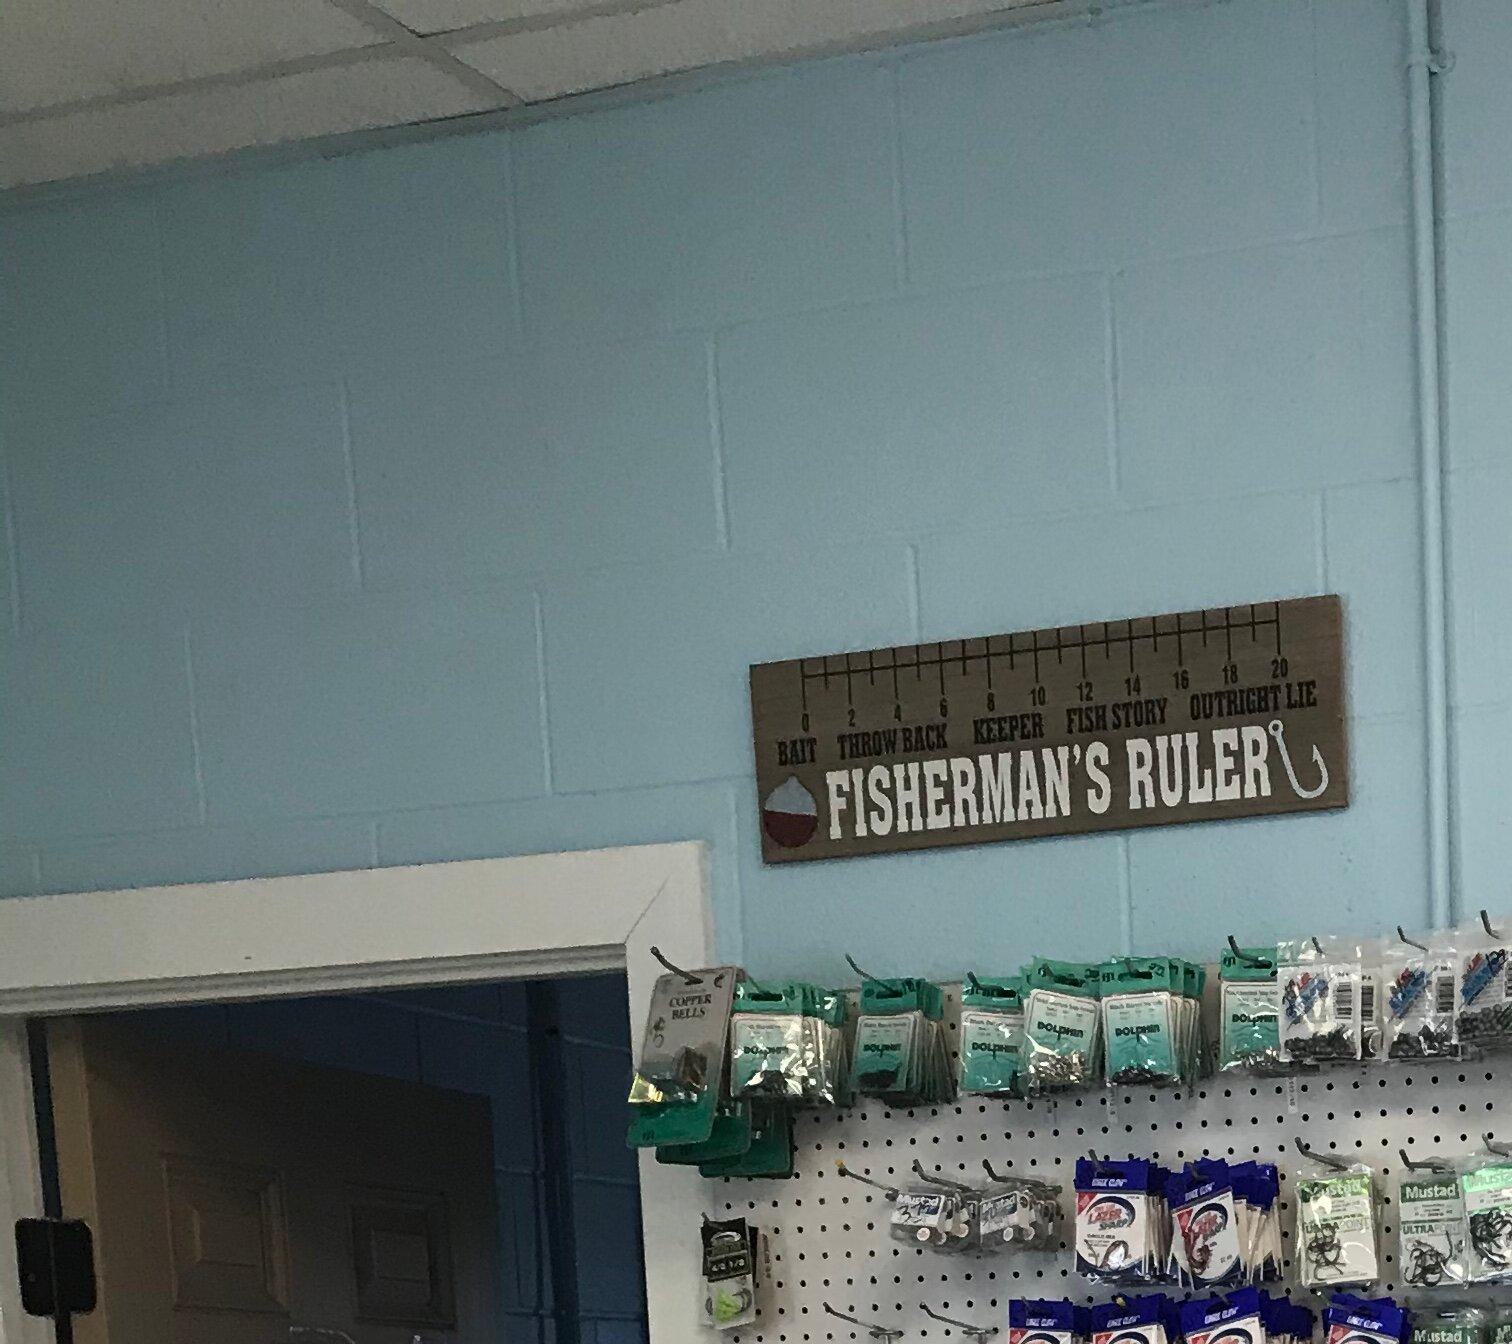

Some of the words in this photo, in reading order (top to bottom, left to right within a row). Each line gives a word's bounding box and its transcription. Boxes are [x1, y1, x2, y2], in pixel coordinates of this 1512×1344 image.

[778, 737, 817, 766] BAIT
[838, 732, 897, 760] THROW
[903, 724, 948, 753] BACK
[973, 714, 1044, 746] KEEPER
[1066, 705, 1107, 734] FISH
[1112, 698, 1168, 730] STORY
[1190, 684, 1281, 721] OUTRIGHT
[1286, 680, 1317, 709] LIE
[826, 740, 1111, 840] FISHERMAN'S
[1125, 724, 1272, 811] RULER
[1037, 1020, 1084, 1041] DOLPHIN
[1115, 1023, 1161, 1043] DOLPHIN
[1405, 1184, 1456, 1199] Mustad
